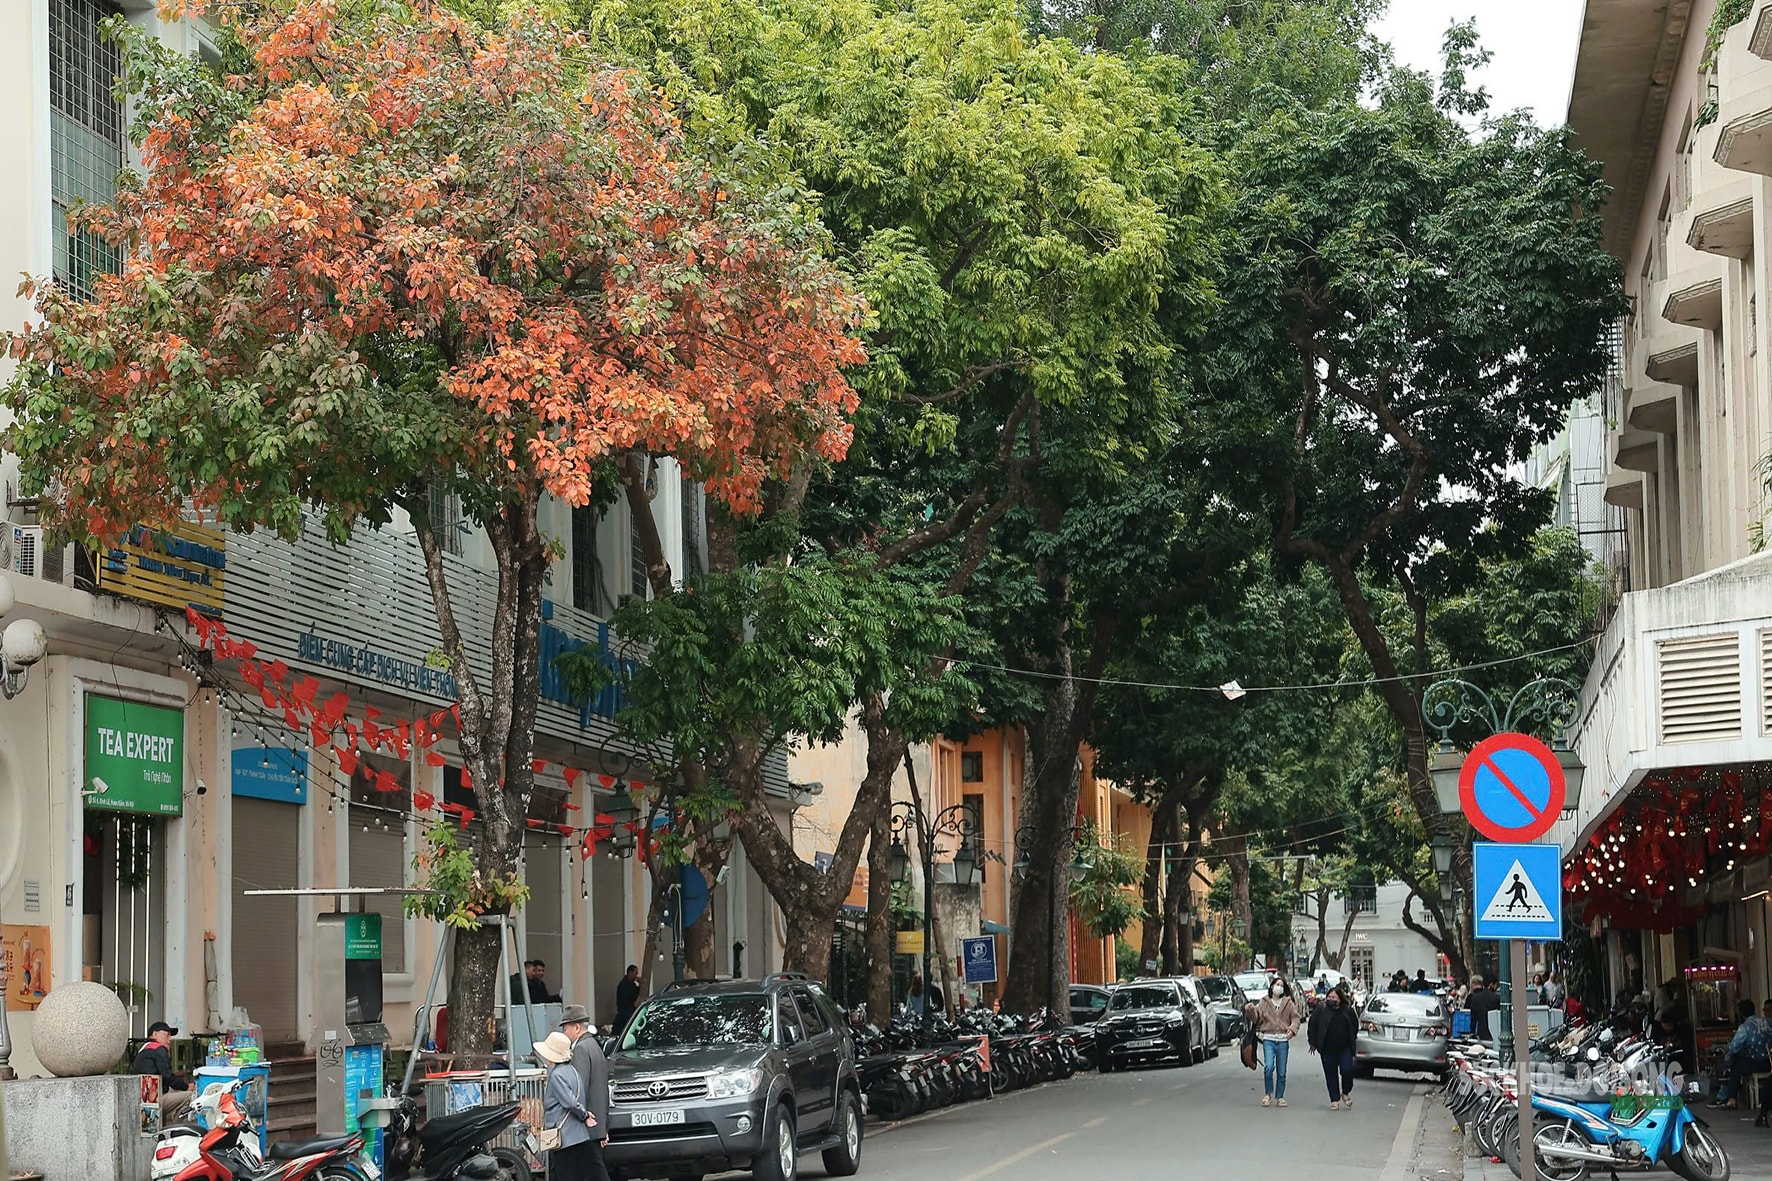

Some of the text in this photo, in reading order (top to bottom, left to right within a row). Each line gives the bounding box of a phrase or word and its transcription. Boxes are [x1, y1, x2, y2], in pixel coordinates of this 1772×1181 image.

[326, 639, 353, 671] CUNG
[98, 727, 174, 763] TEA EXPERT
[1355, 932, 1369, 940] IWC
